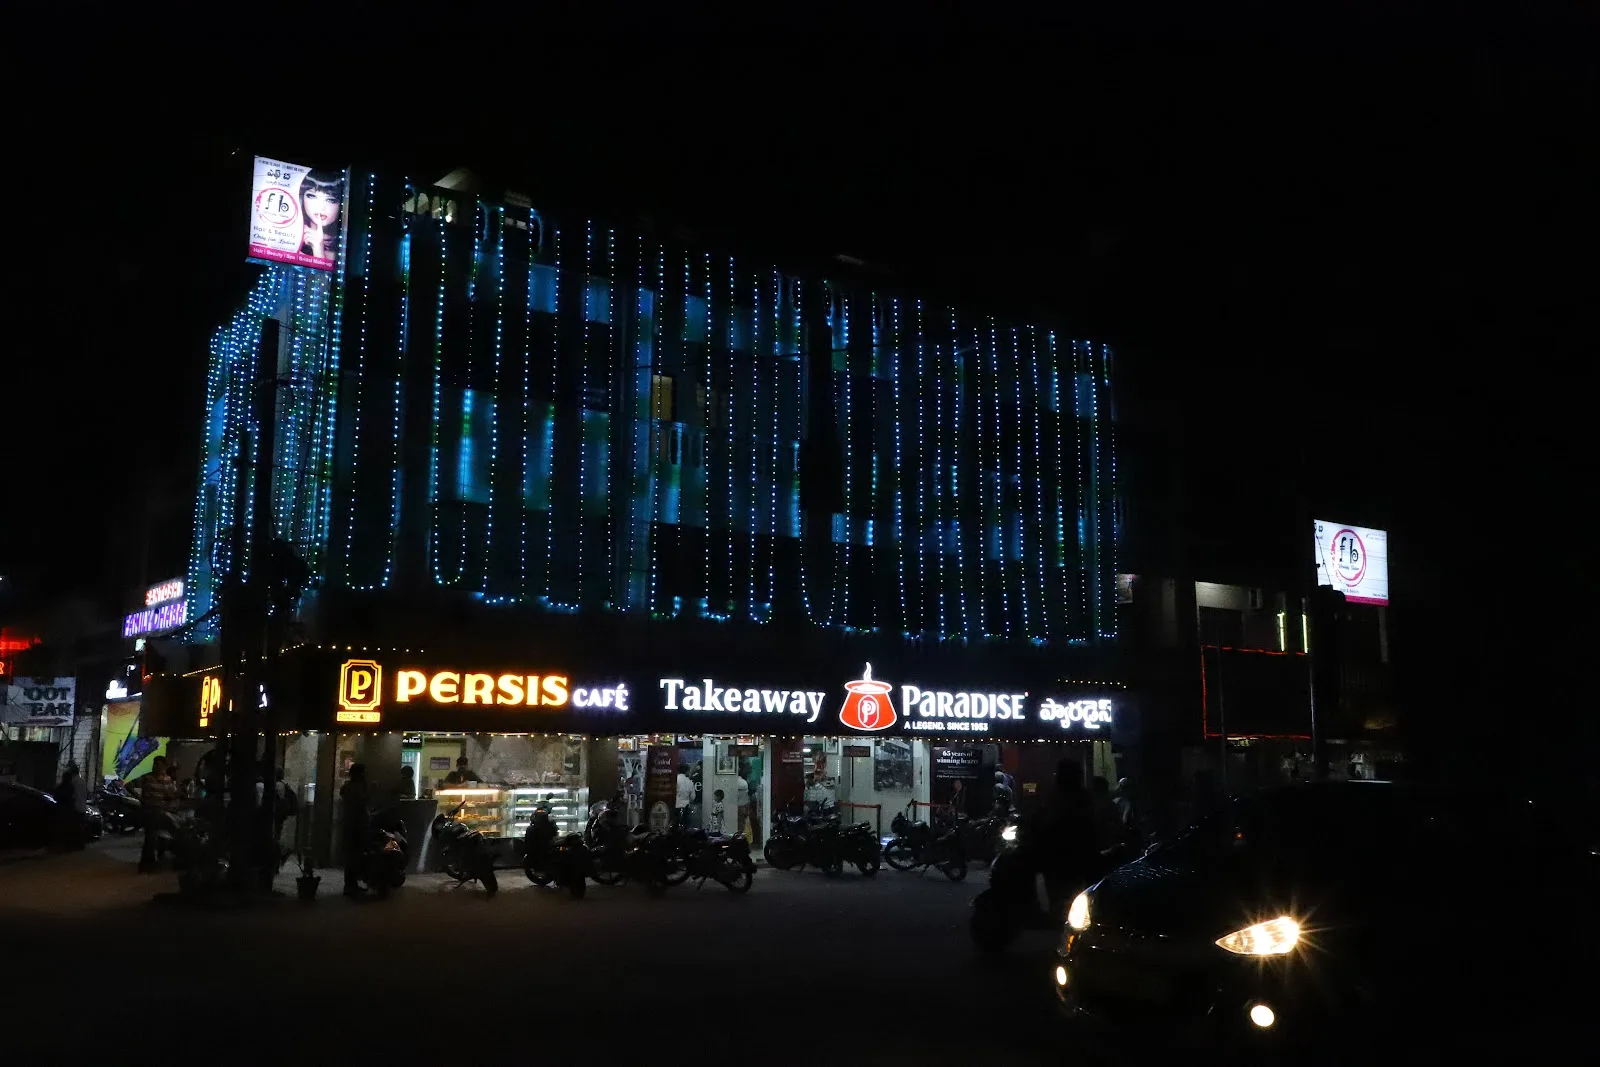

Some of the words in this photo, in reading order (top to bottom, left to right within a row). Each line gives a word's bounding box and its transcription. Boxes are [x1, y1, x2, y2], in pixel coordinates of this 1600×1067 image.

[395, 669, 569, 707] PERSIS
[573, 683, 629, 711] CAFÉ
[659, 678, 826, 723] Takeaway
[903, 721, 911, 730] A
[912, 720, 946, 731] LEGEND.
[947, 721, 970, 731] SINCE
[970, 722, 989, 732] 1953
